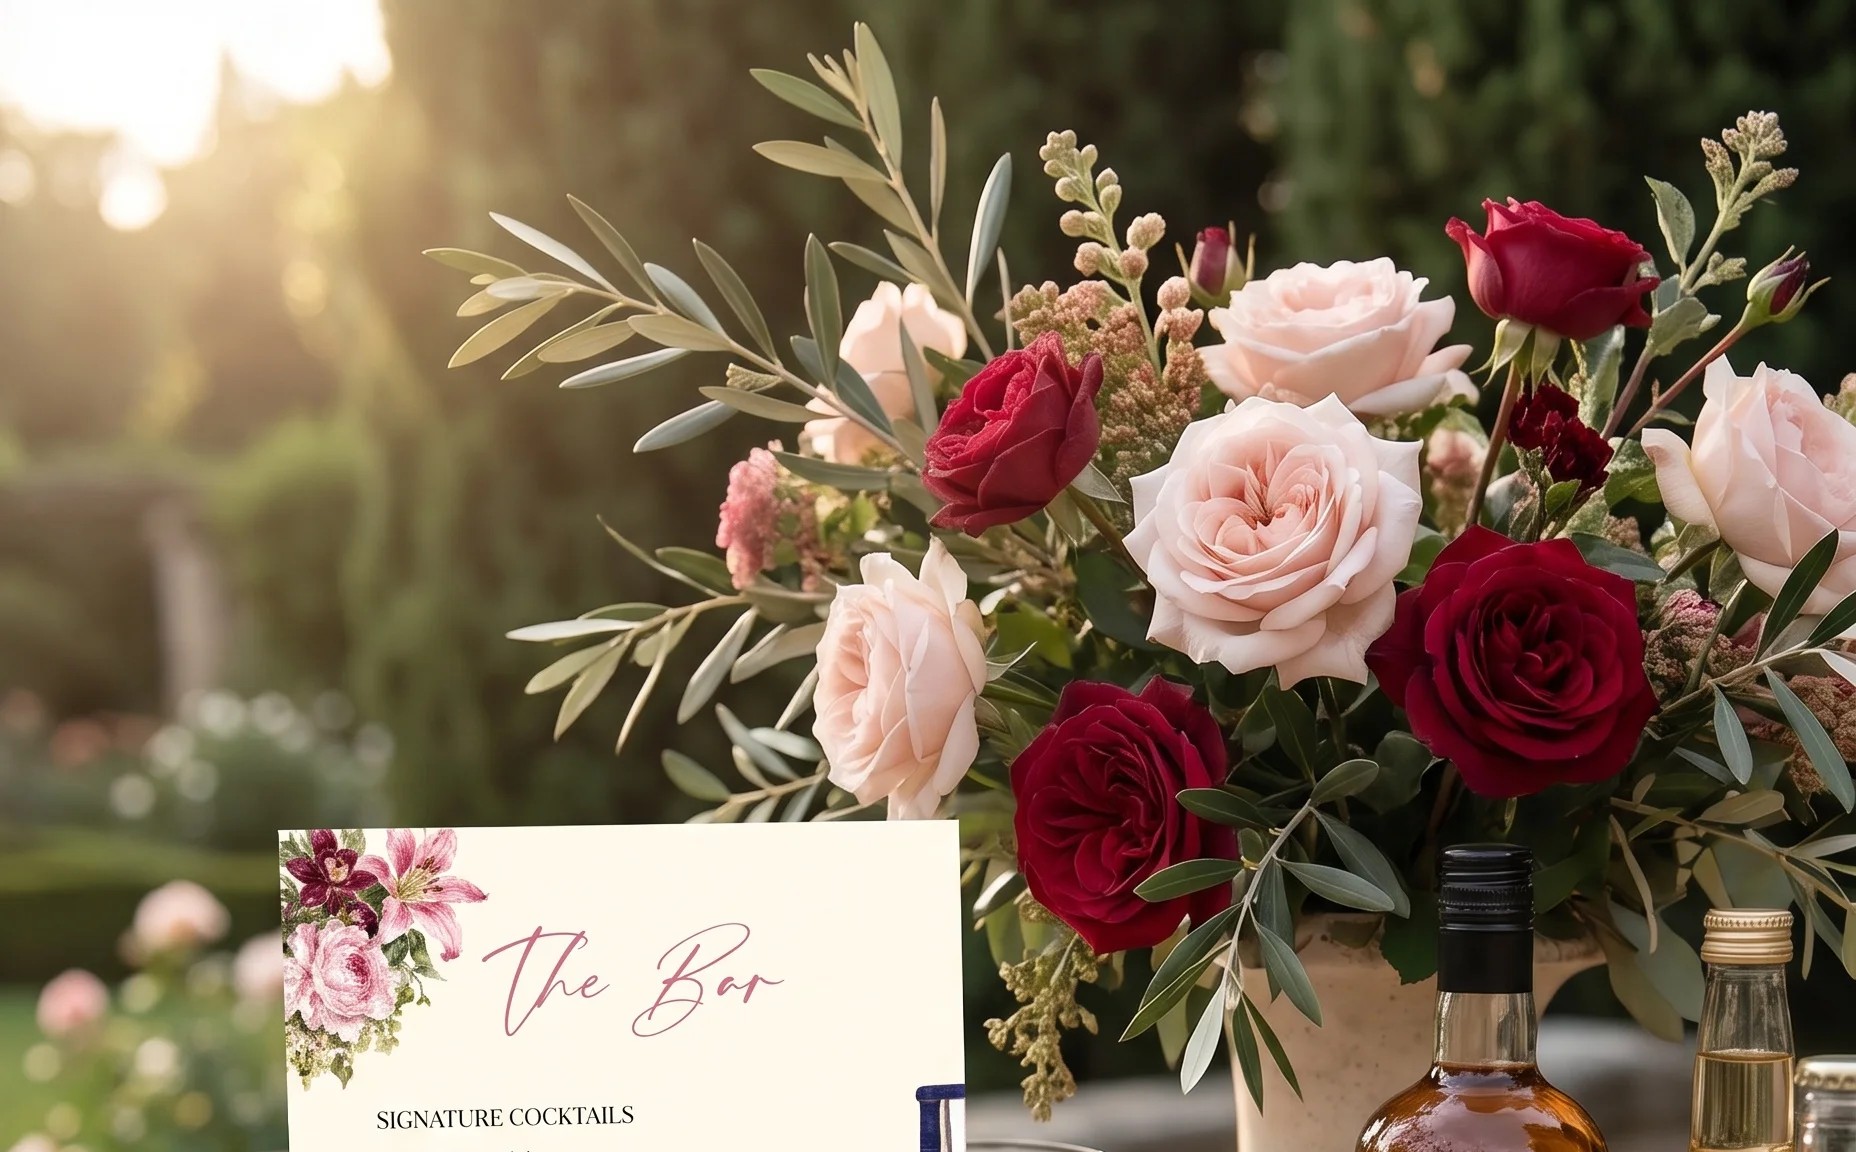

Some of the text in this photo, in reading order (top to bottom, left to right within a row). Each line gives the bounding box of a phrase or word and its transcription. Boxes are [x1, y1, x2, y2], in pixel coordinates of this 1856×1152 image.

[481, 922, 785, 1038] The Bar
[376, 1105, 635, 1130] SIGNATURE COCKTAILS
